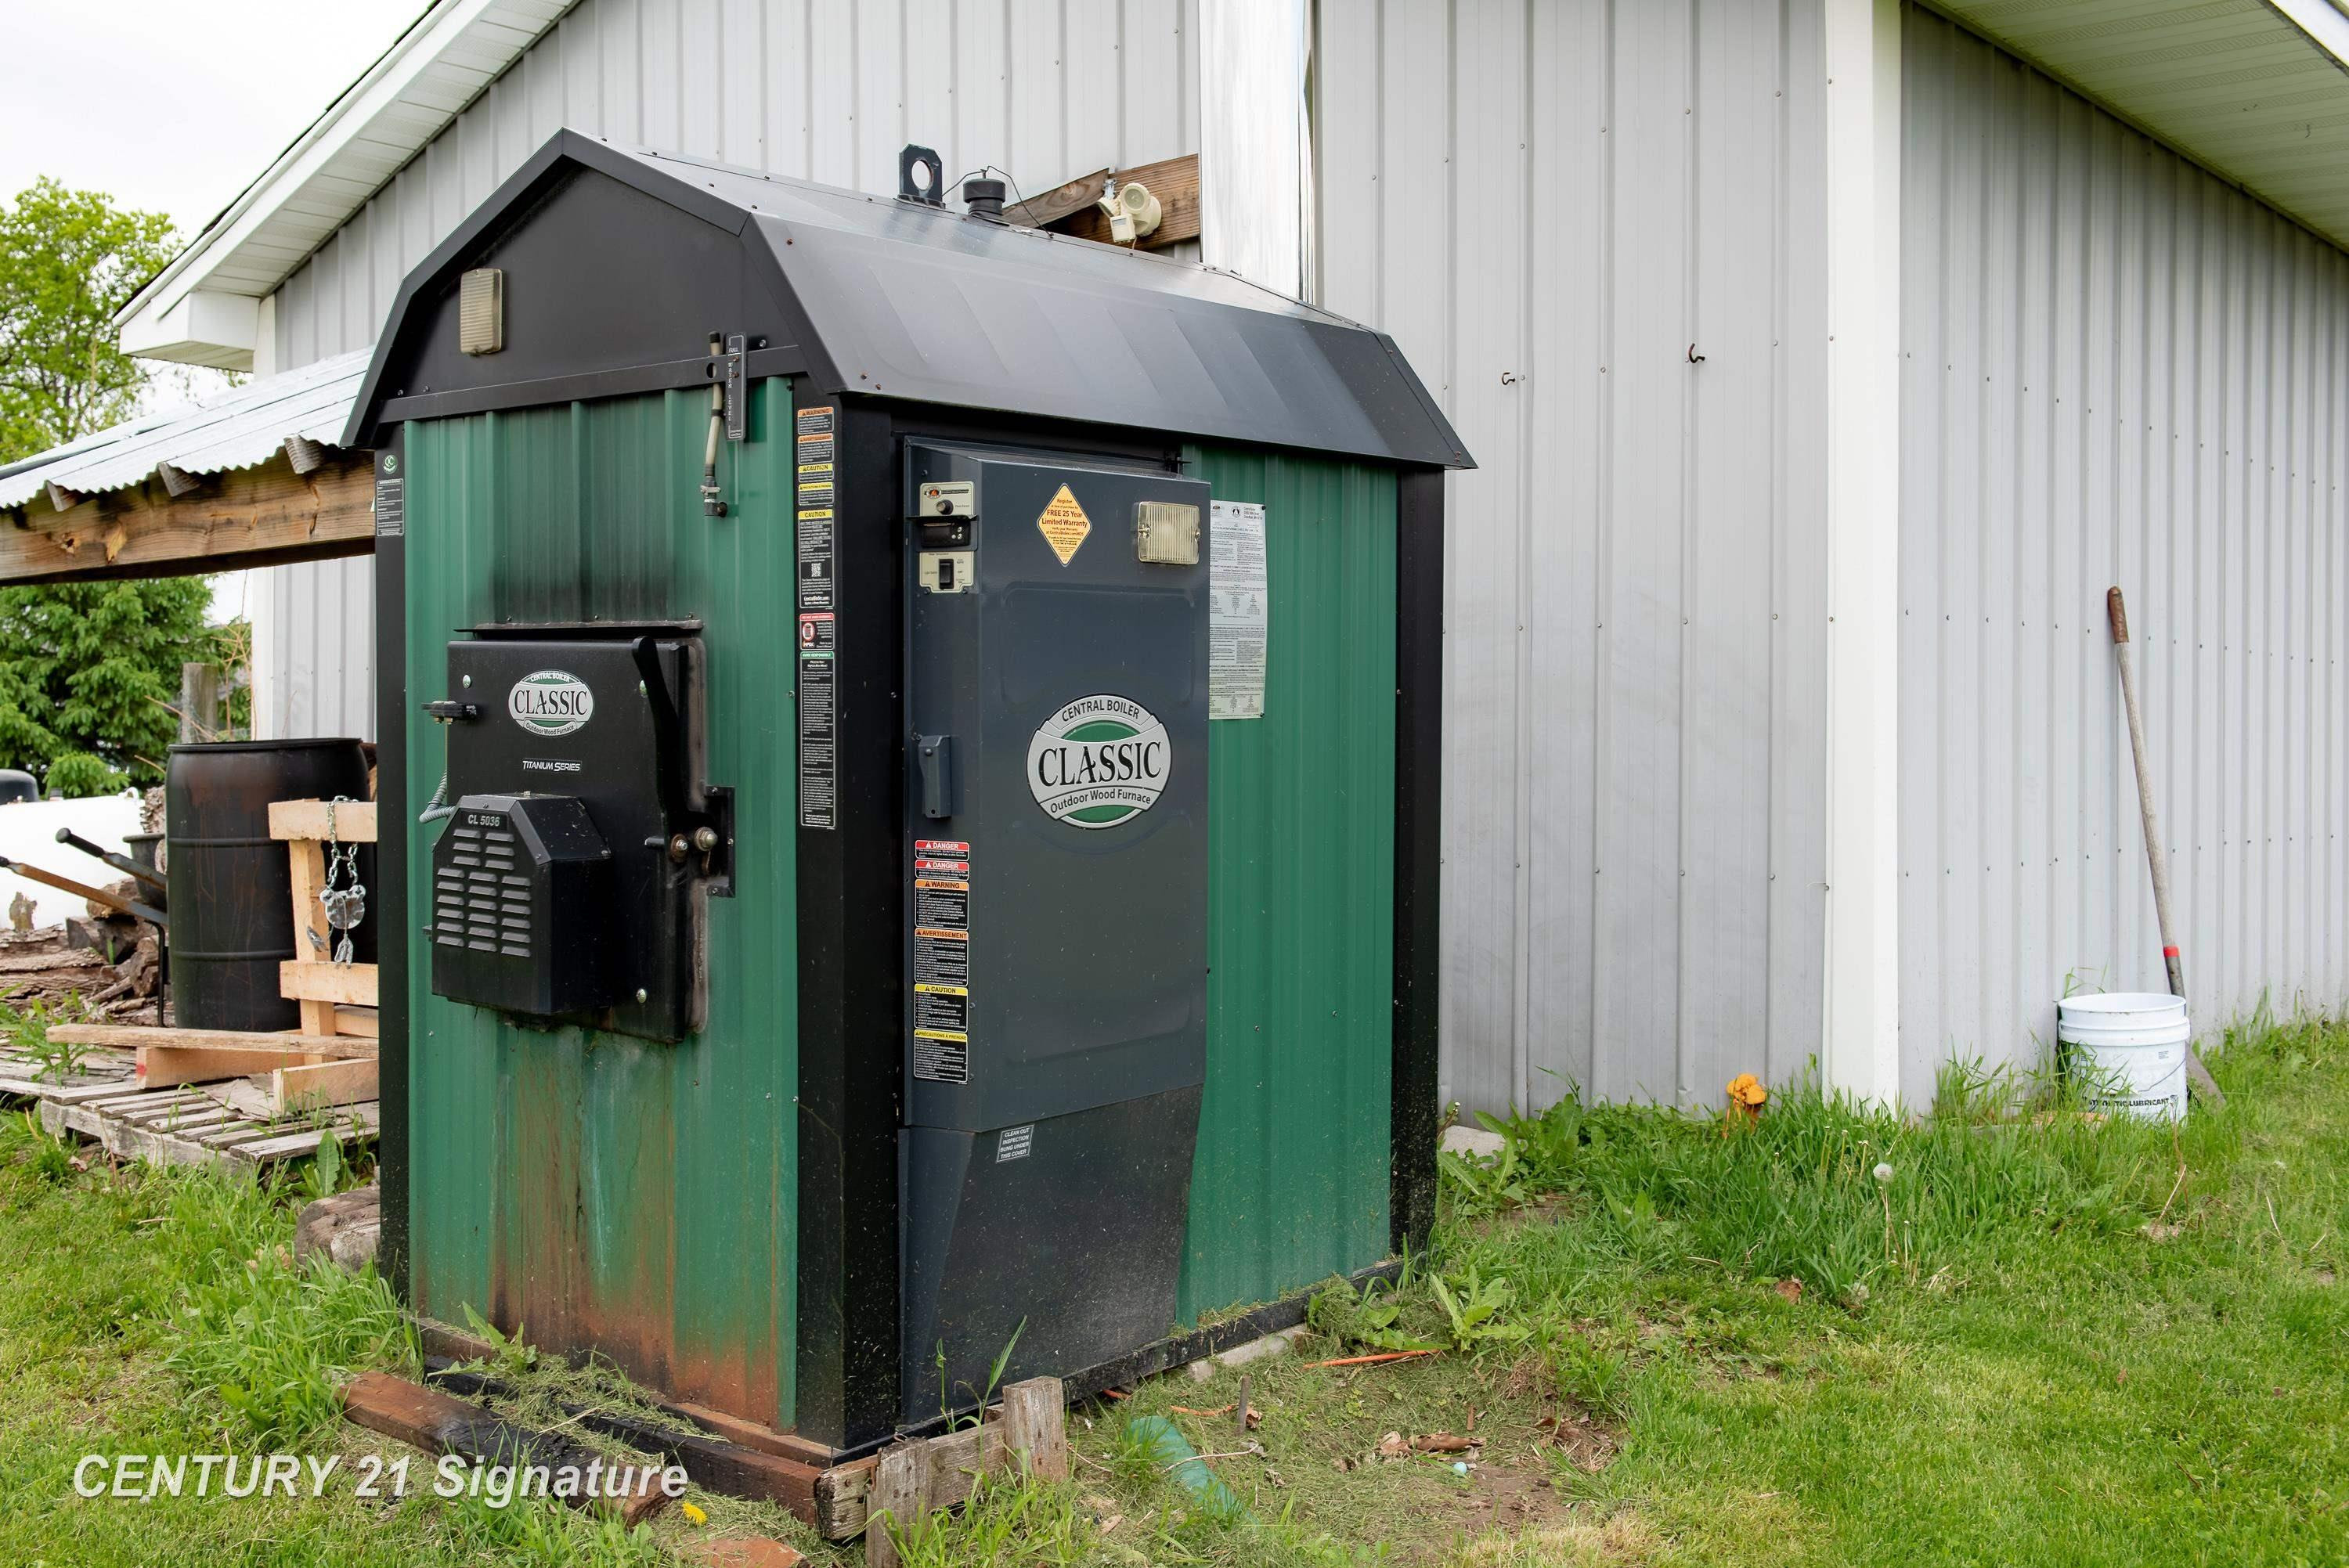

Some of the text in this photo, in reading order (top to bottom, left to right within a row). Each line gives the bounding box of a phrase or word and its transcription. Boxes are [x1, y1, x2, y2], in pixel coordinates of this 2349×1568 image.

[1063, 519, 1087, 528] Warranty
[531, 673, 570, 682] CENTRAL BOILER
[514, 690, 587, 715] CLASSIC
[1062, 700, 1139, 721] CENTRAL BOILER
[526, 723, 544, 734] Outdoor
[557, 725, 574, 734] Furnace
[523, 761, 580, 771] TITANIUM SERIES
[1039, 741, 1161, 786] CLASSIC
[1050, 789, 1151, 813] Outdoor Wood Furnace
[468, 814, 500, 827] CL 5036
[922, 930, 967, 938] AVERTISSEMENT
[2130, 1098, 2169, 1106] LUBRICANT
[1002, 1135, 1029, 1145] INSPECTION
